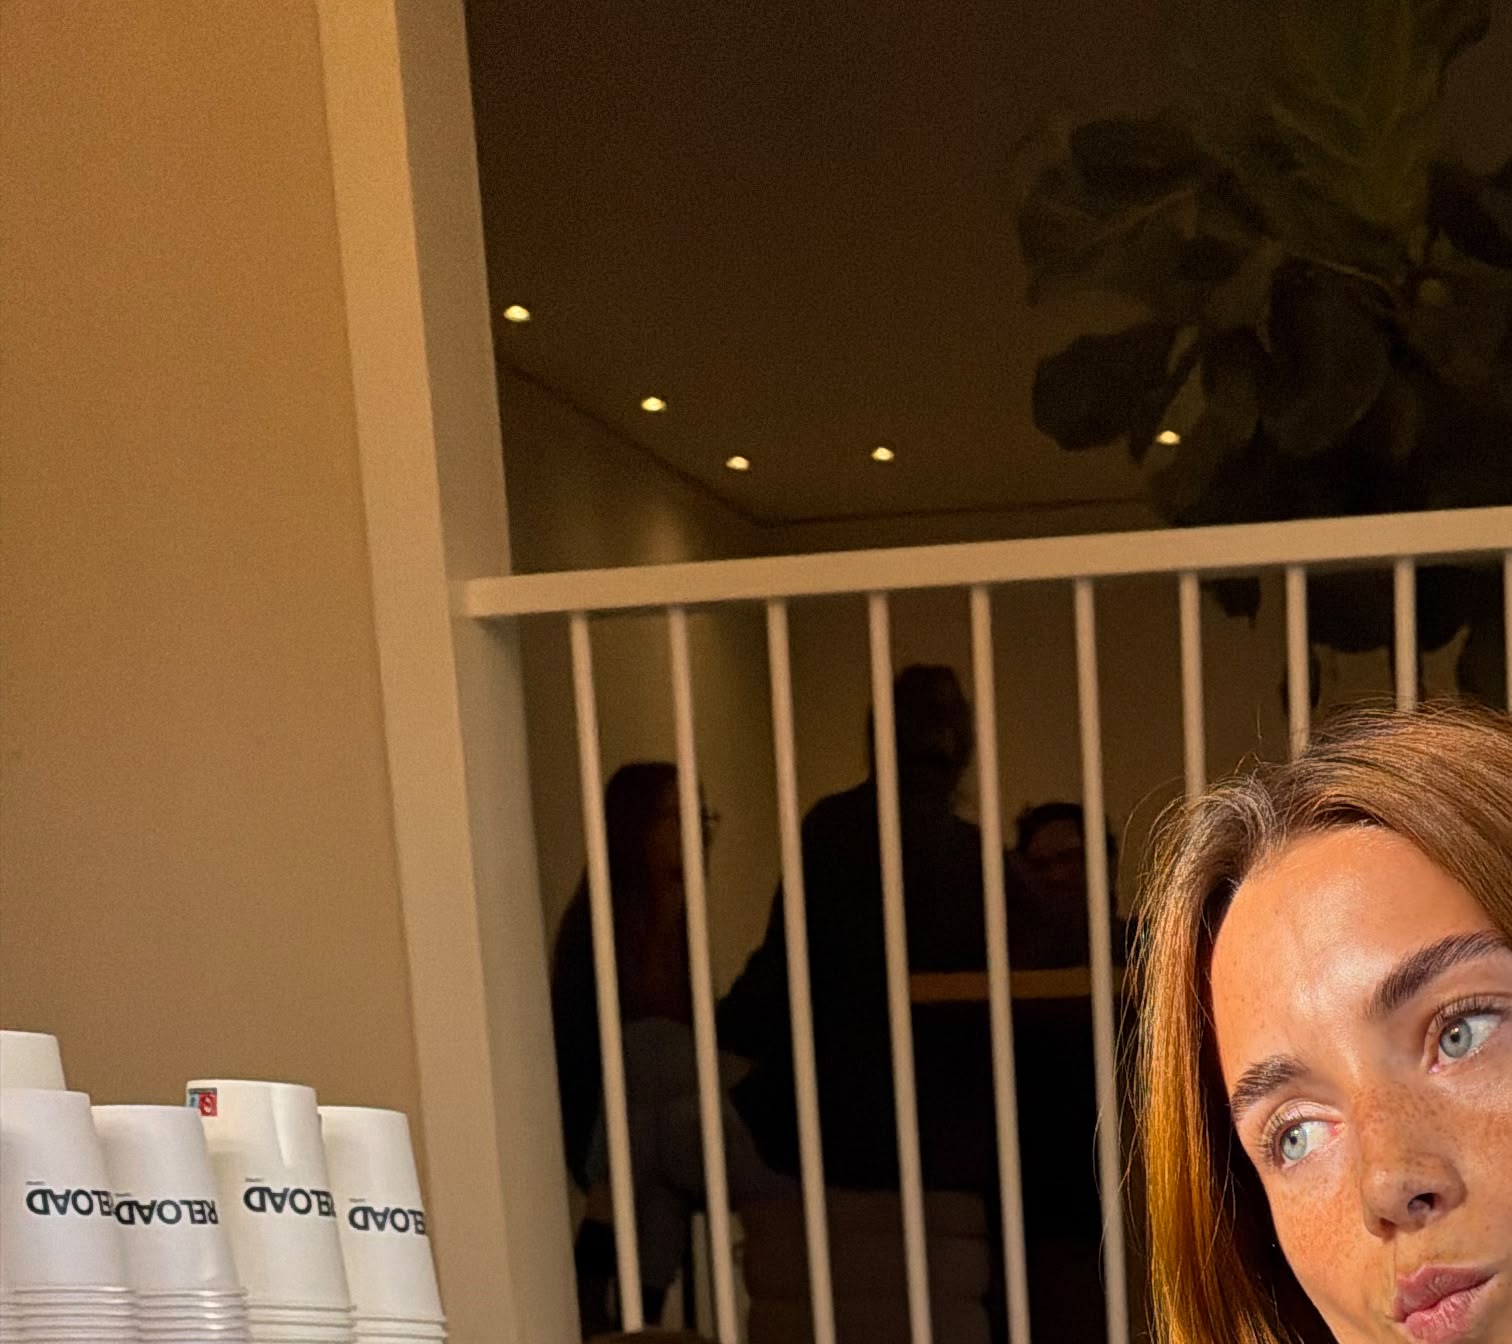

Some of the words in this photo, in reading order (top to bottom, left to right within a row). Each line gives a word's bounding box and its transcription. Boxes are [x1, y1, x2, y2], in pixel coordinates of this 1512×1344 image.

[26, 1188, 114, 1216] ELOAD
[114, 1199, 219, 1225] RELOAD
[348, 1206, 426, 1235] ELOAD
